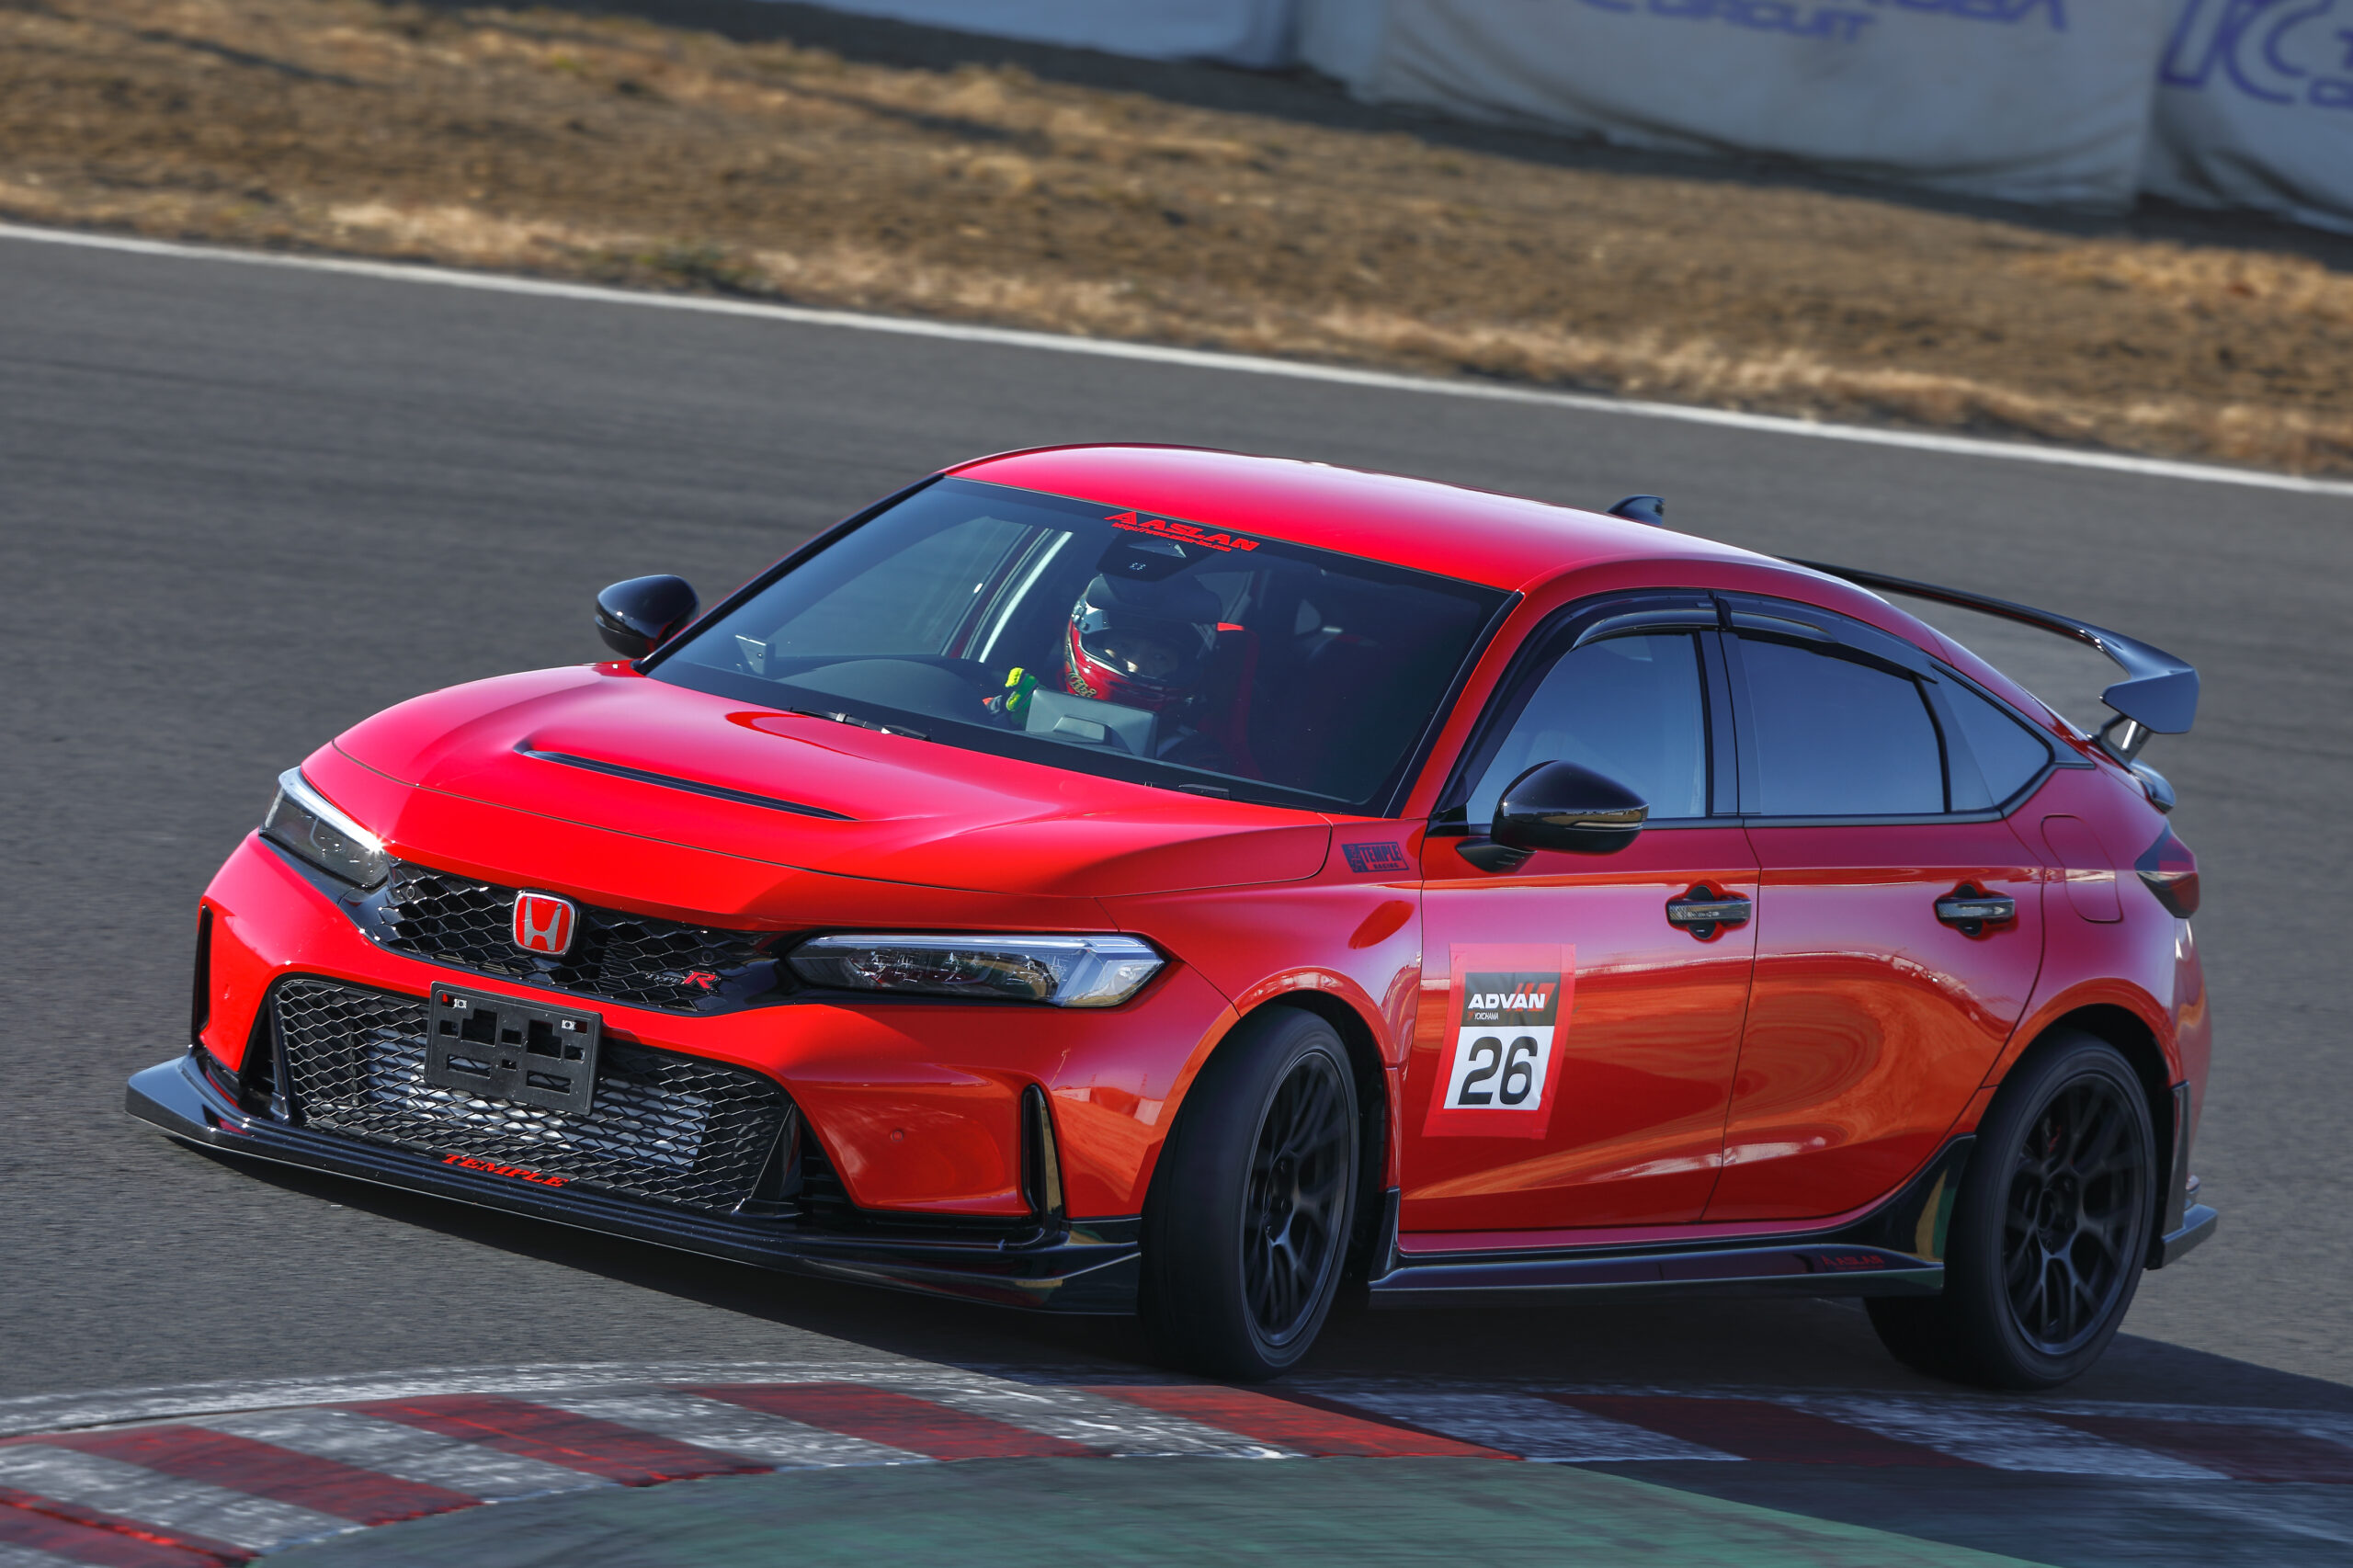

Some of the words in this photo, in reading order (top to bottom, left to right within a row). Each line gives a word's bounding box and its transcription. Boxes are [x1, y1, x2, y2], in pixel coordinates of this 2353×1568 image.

[1359, 846, 1402, 863] TEMPLE
[1468, 993, 1546, 1009] ADVAN
[1474, 1012, 1499, 1020] YOKOHAMA
[1458, 1036, 1539, 1106] 26
[442, 1153, 570, 1187] TEMPLE
